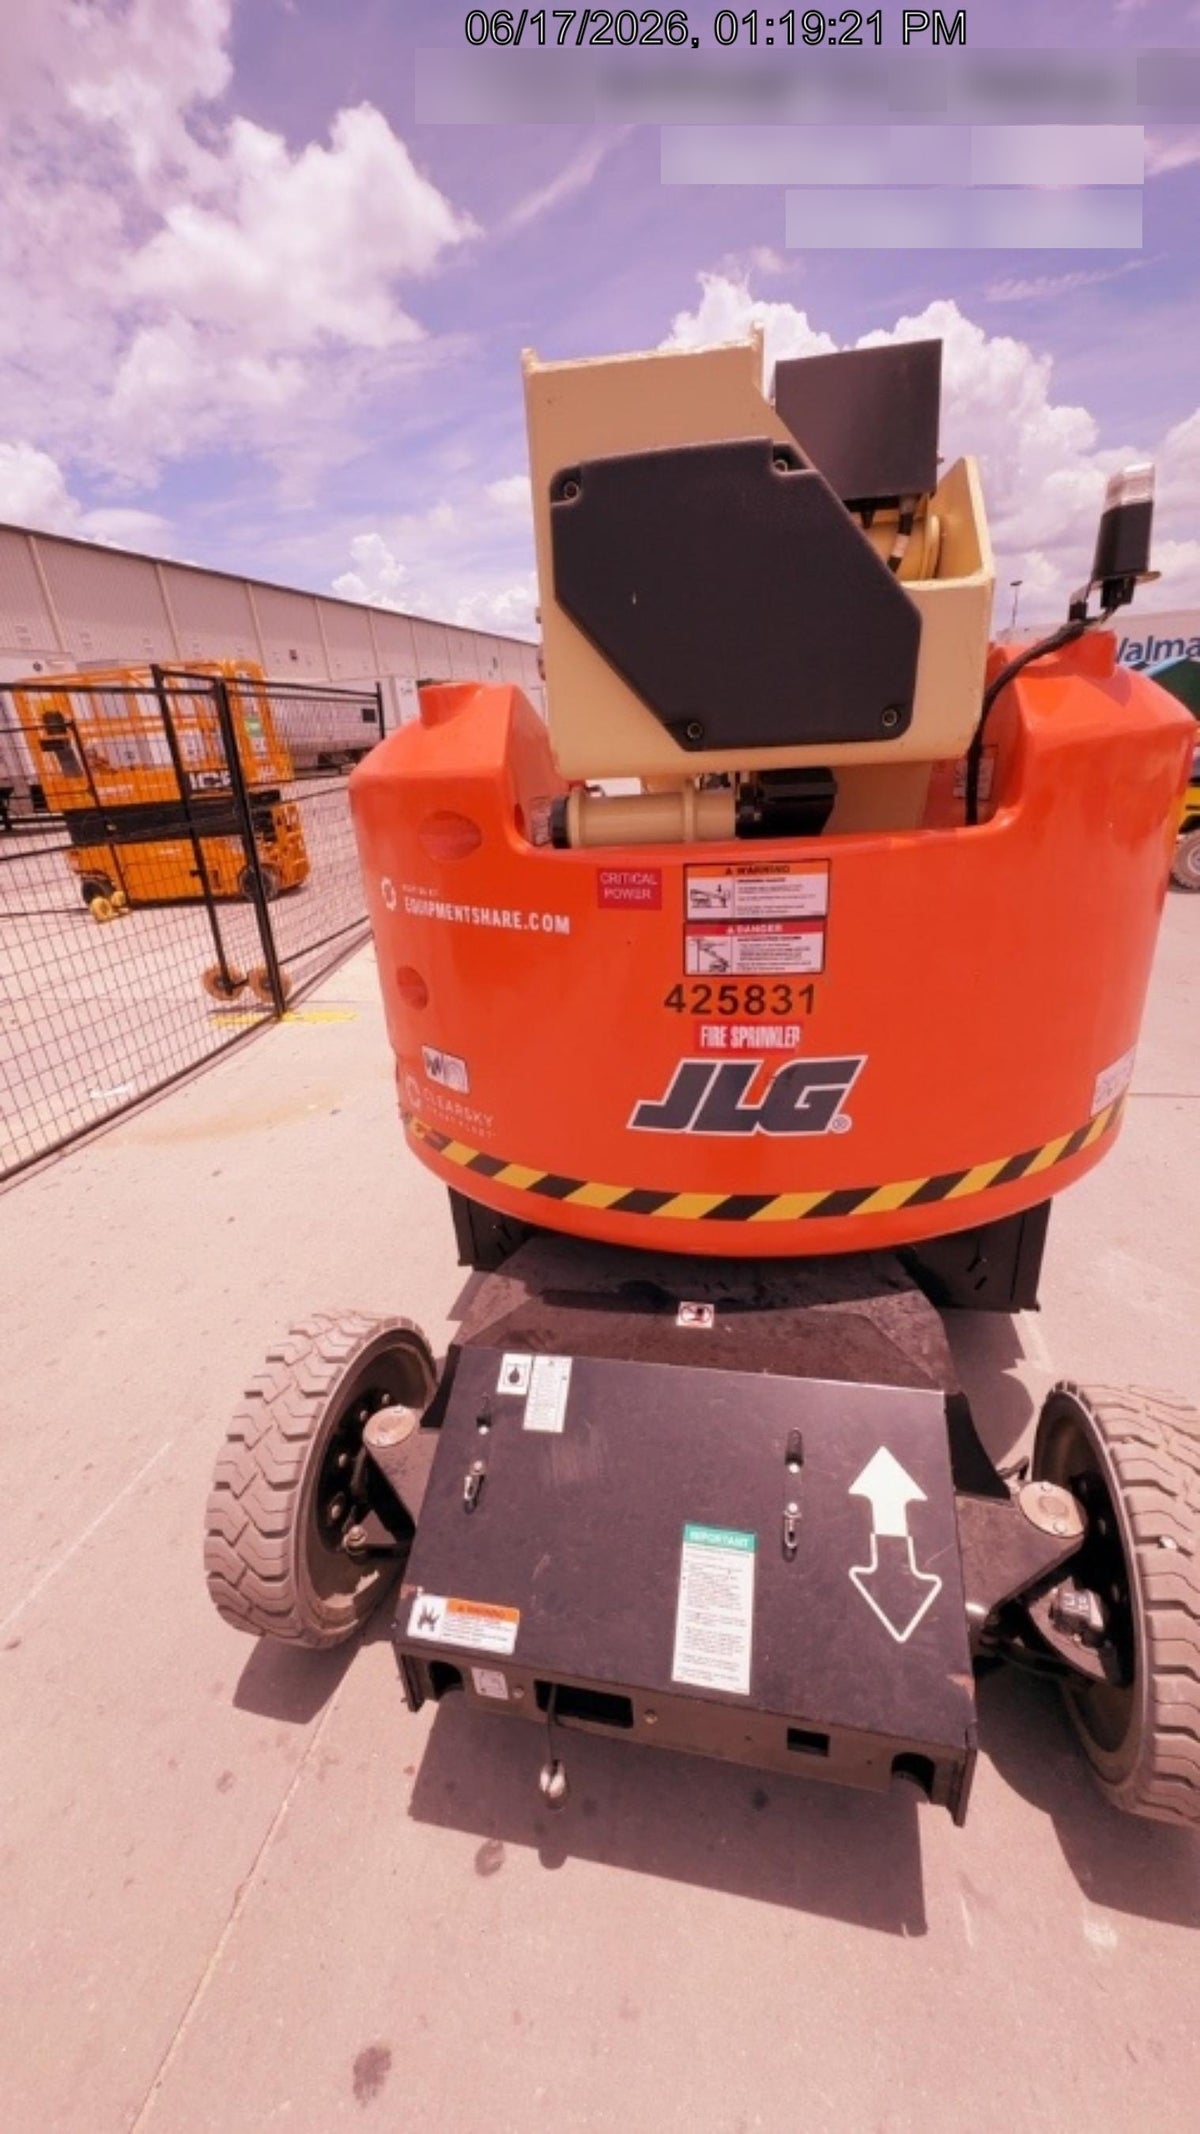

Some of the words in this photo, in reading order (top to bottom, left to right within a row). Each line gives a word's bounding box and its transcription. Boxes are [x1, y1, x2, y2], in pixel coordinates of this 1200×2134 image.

[600, 872, 658, 886] CRITICAL
[604, 887, 652, 900] POWER
[404, 896, 571, 935] EQUIPMENTSHARE.COM
[663, 983, 816, 1016] 425831
[700, 1025, 727, 1048] FIRE
[730, 1025, 801, 1049] SPRINKLER
[626, 1054, 869, 1137] JLG
